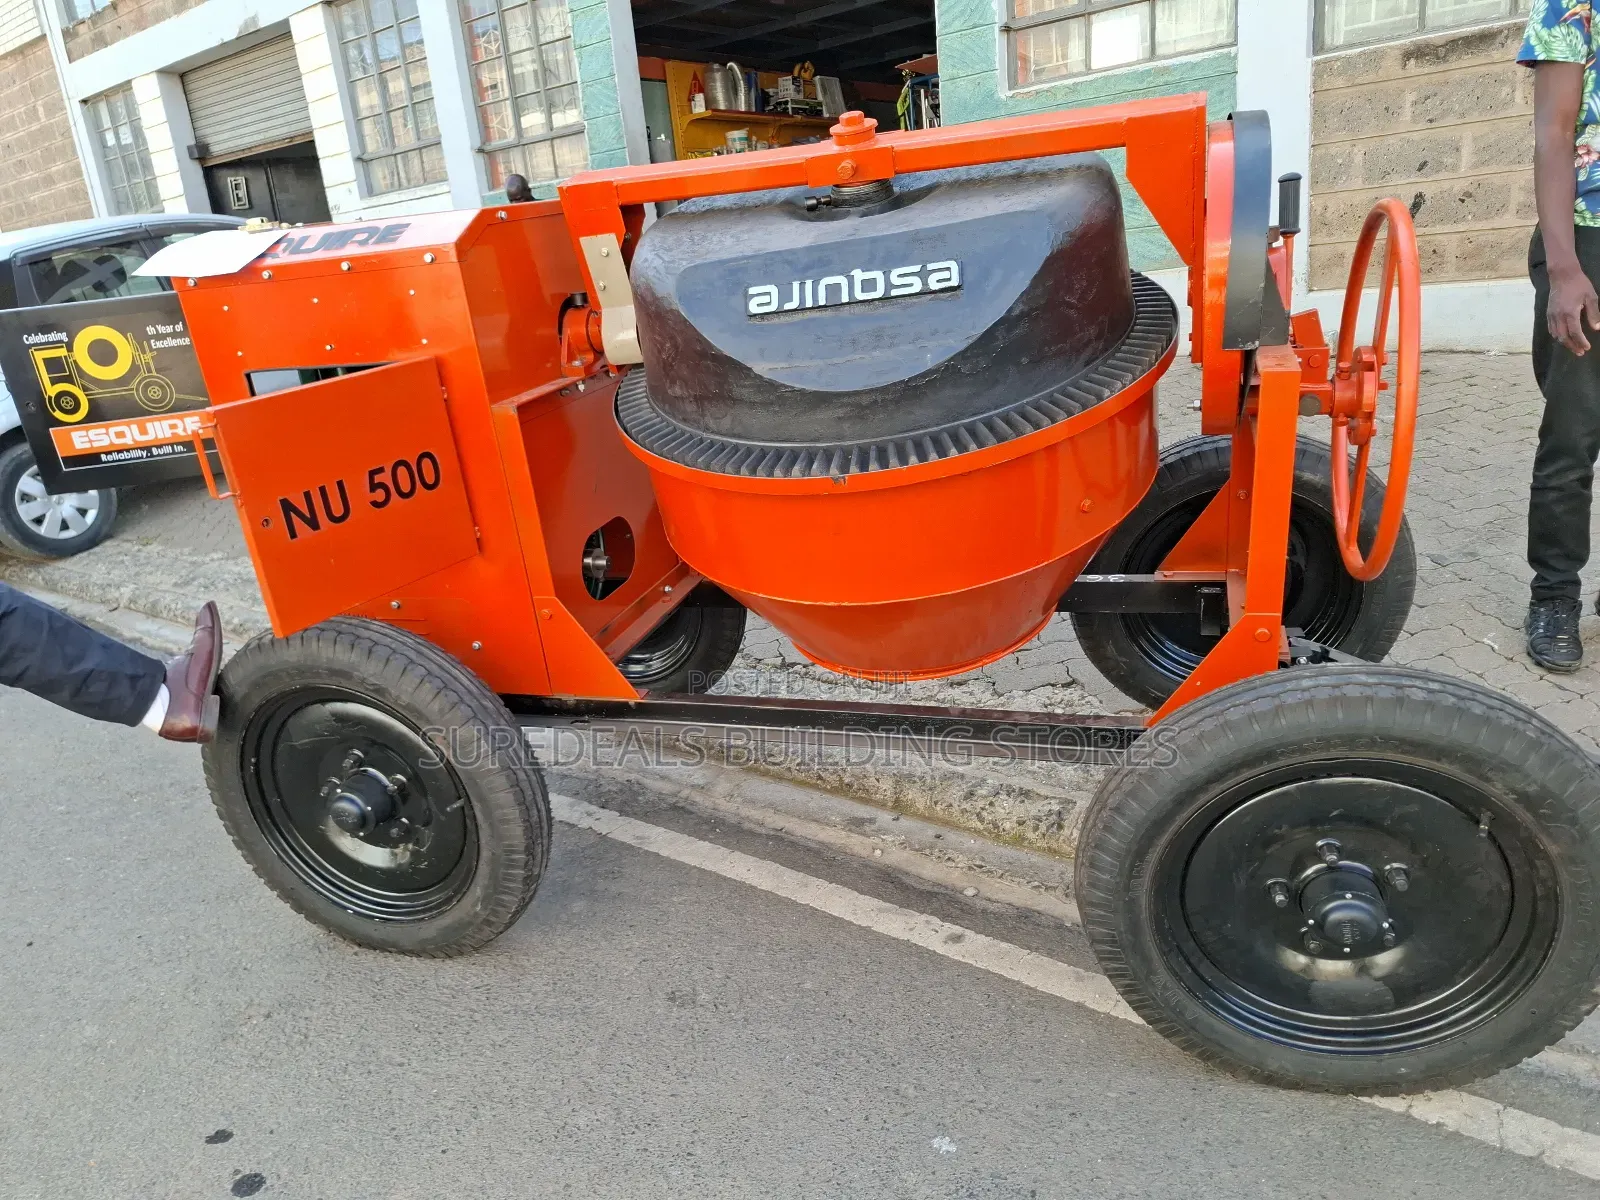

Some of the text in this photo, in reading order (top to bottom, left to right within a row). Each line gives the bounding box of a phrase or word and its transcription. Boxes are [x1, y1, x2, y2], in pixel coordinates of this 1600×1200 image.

[146, 321, 184, 335] th Year of
[23, 330, 69, 345] Celebrating
[151, 337, 191, 349] Excellence
[152, 445, 172, 456] Built
[279, 451, 441, 540] NU 500
